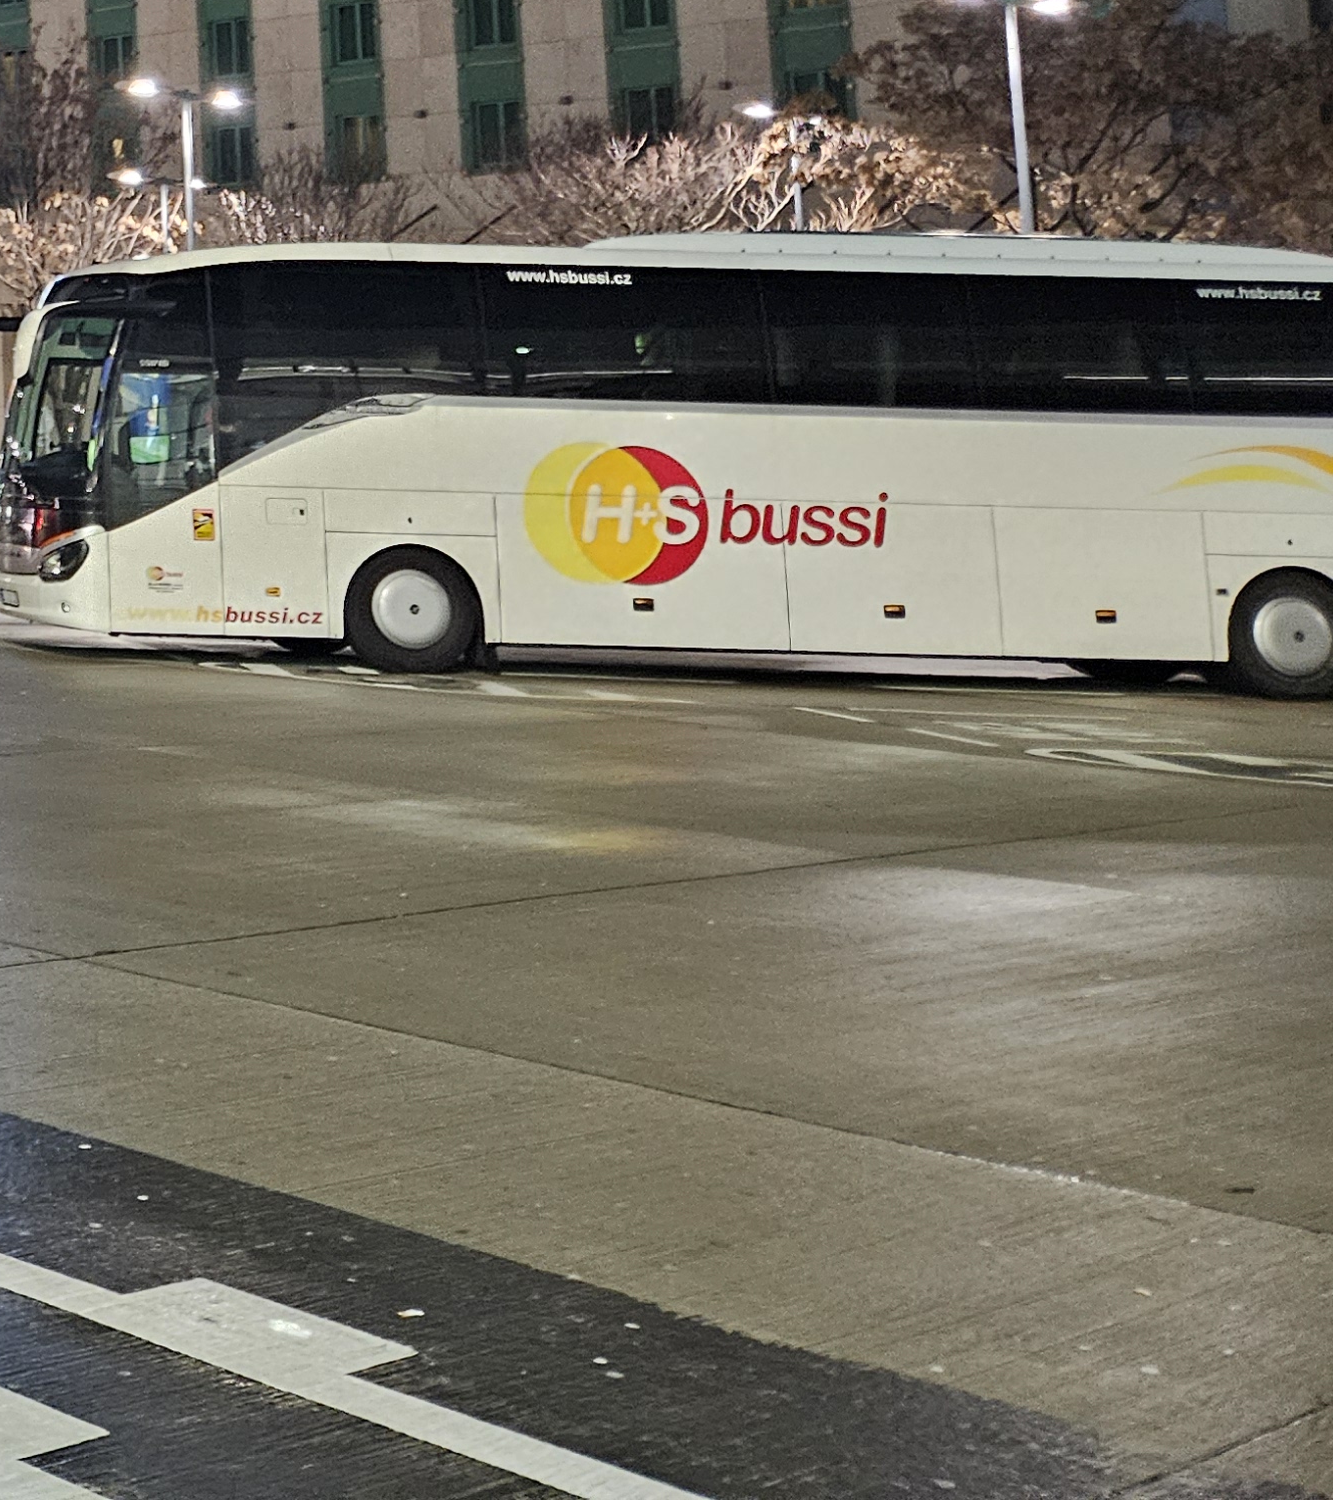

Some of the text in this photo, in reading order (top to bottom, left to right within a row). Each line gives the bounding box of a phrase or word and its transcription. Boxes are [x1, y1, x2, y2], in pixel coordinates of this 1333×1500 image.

[505, 269, 633, 286] www.hsbussi.cz
[1195, 285, 1322, 301] www.hsbussi.cz
[582, 483, 889, 548] H+S bussi
